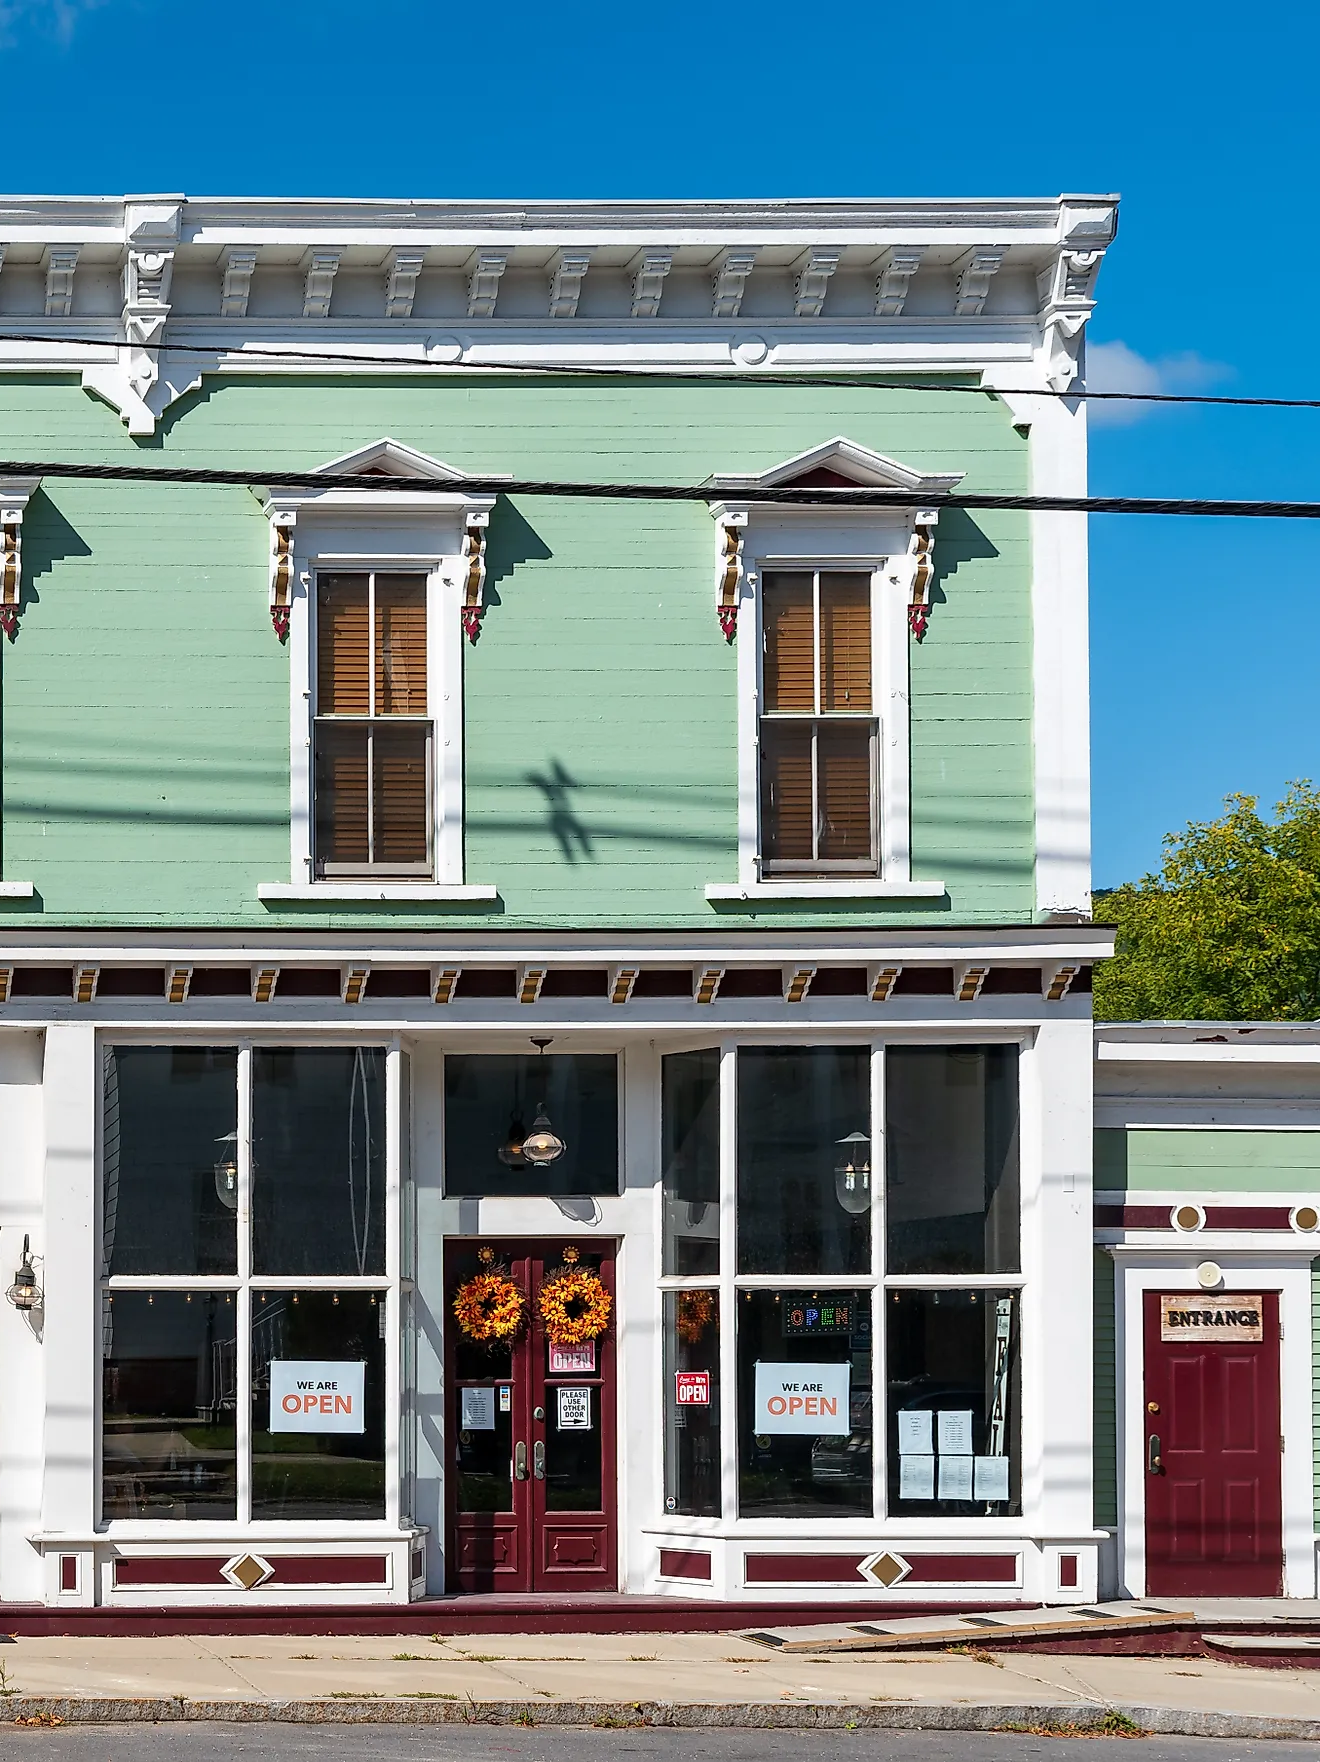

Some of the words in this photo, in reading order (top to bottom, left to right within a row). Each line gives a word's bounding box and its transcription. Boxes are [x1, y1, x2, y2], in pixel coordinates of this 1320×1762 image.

[790, 1308, 848, 1326] OPEN
[1168, 1310, 1260, 1327] ENTRANCE
[553, 1353, 591, 1369] OPEN
[296, 1381, 314, 1390] WE
[317, 1381, 338, 1390] ARE
[680, 1385, 707, 1402] OPEN
[782, 1382, 799, 1392] WE
[802, 1383, 823, 1392] ARE
[561, 1391, 587, 1399] PLEASE
[282, 1394, 352, 1414] OPEN
[767, 1396, 837, 1416] OPEN
